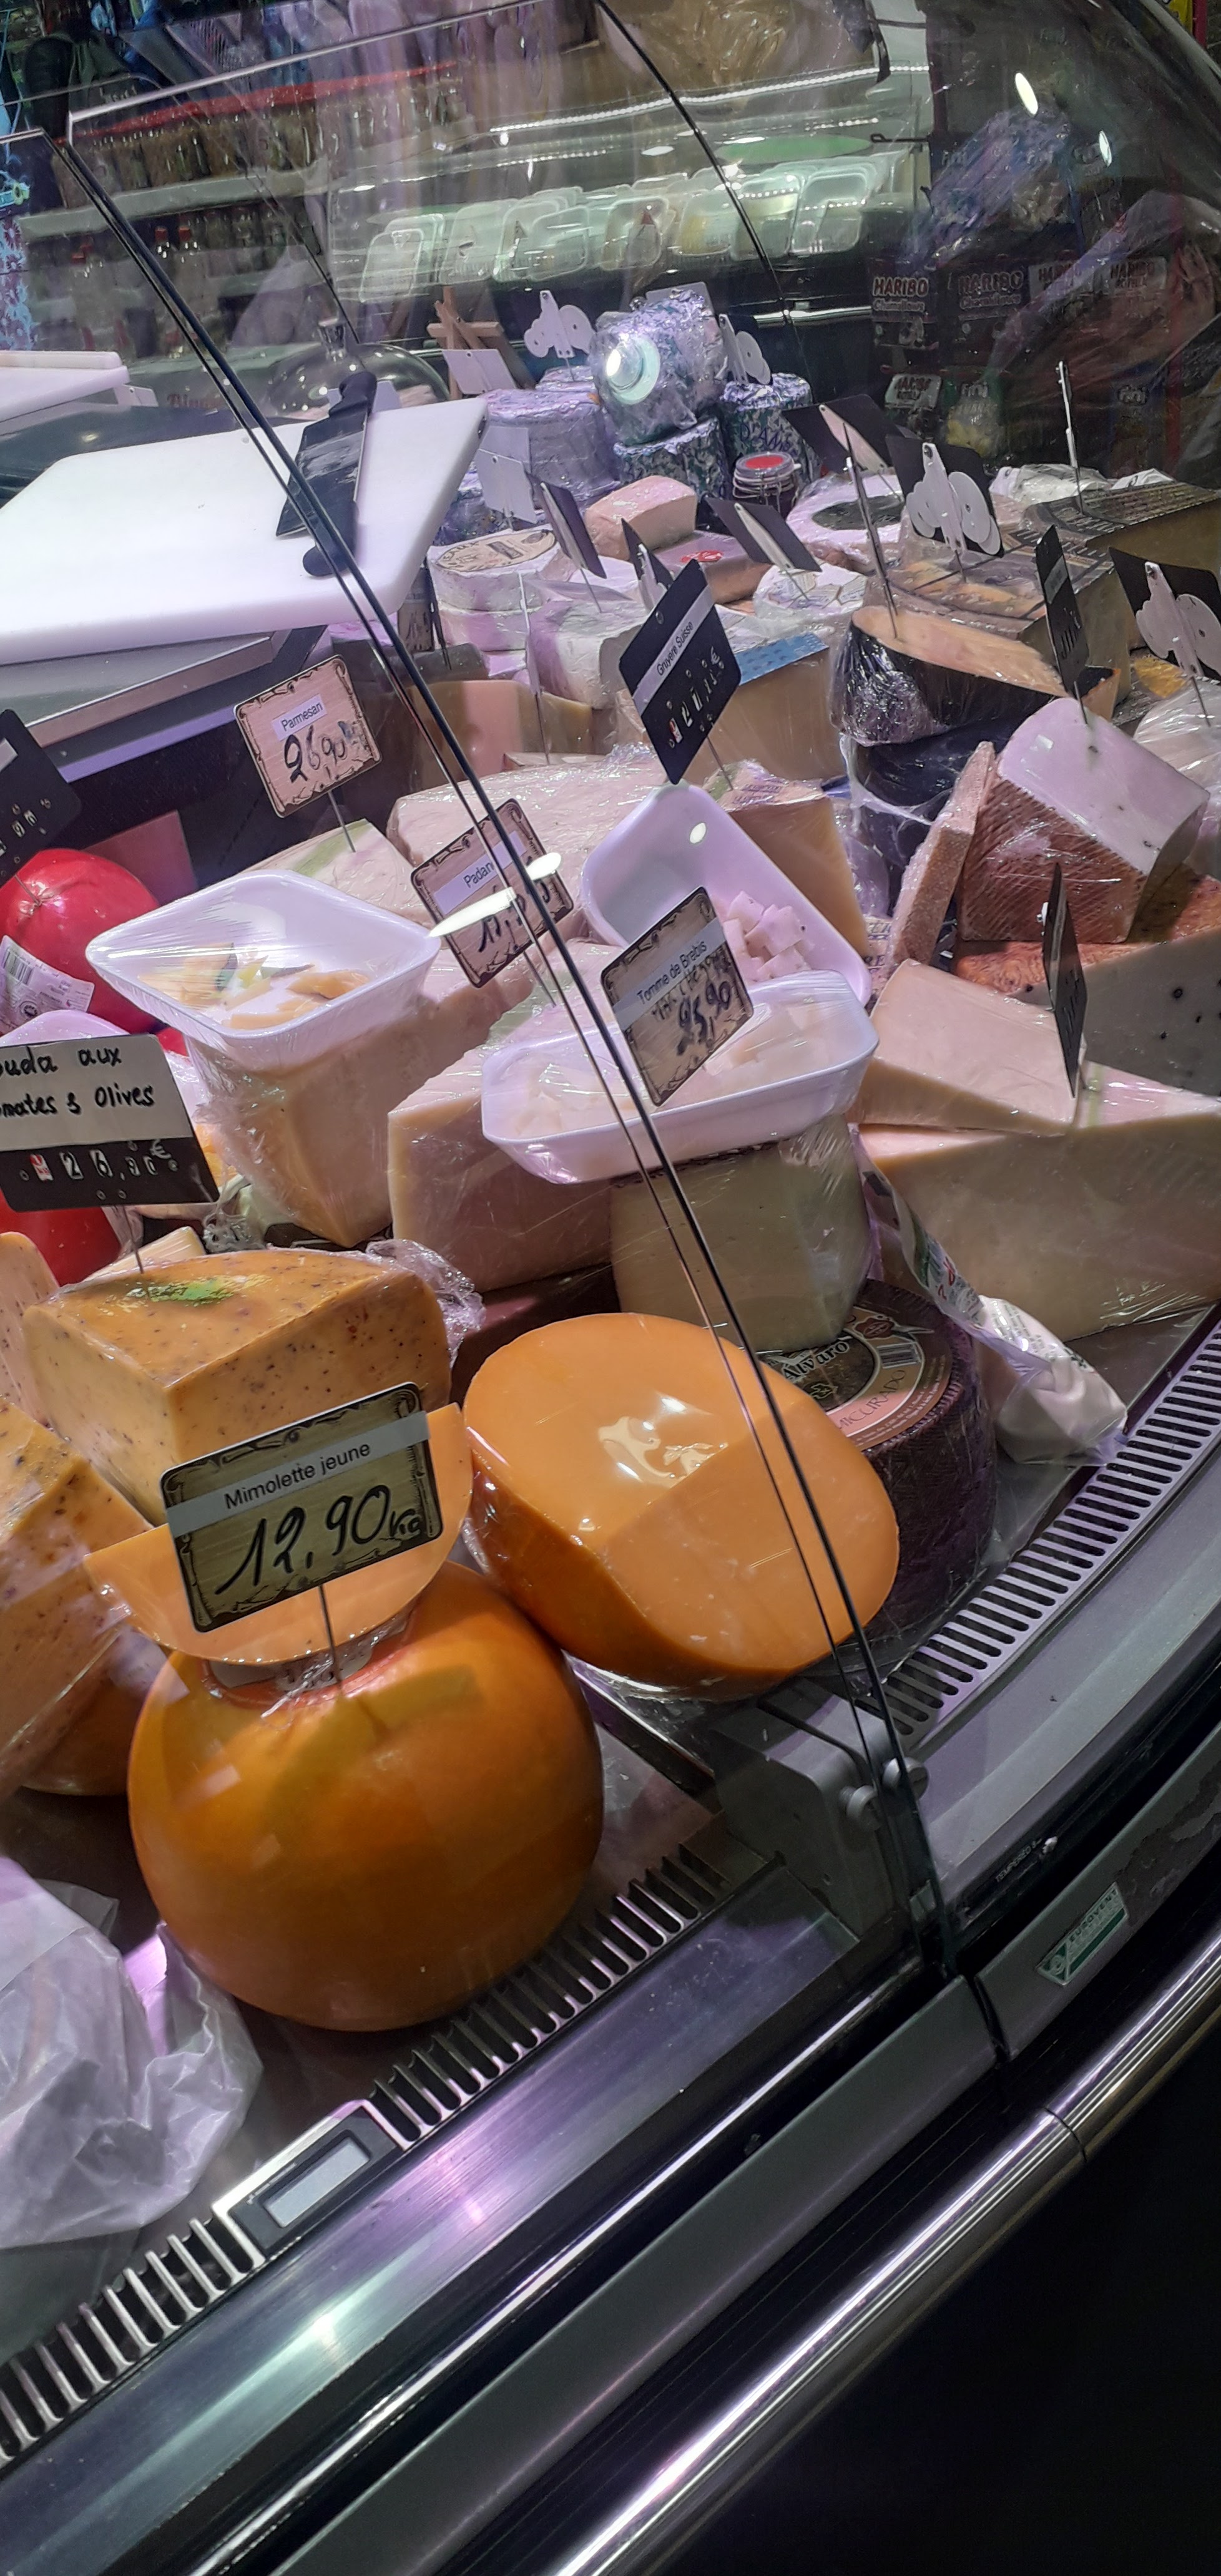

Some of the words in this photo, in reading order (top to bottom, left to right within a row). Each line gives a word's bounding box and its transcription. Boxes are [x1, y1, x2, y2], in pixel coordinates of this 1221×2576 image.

[873, 276, 929, 298] HARIBO
[281, 701, 323, 732] Parmesan
[637, 973, 670, 1005] Tomme
[669, 963, 681, 979] de
[679, 940, 707, 968] Brebis
[78, 1047, 122, 1066] aux
[95, 1083, 155, 1108] Olives
[224, 1461, 316, 1510] Mimolette
[320, 1443, 371, 1475] jeune
